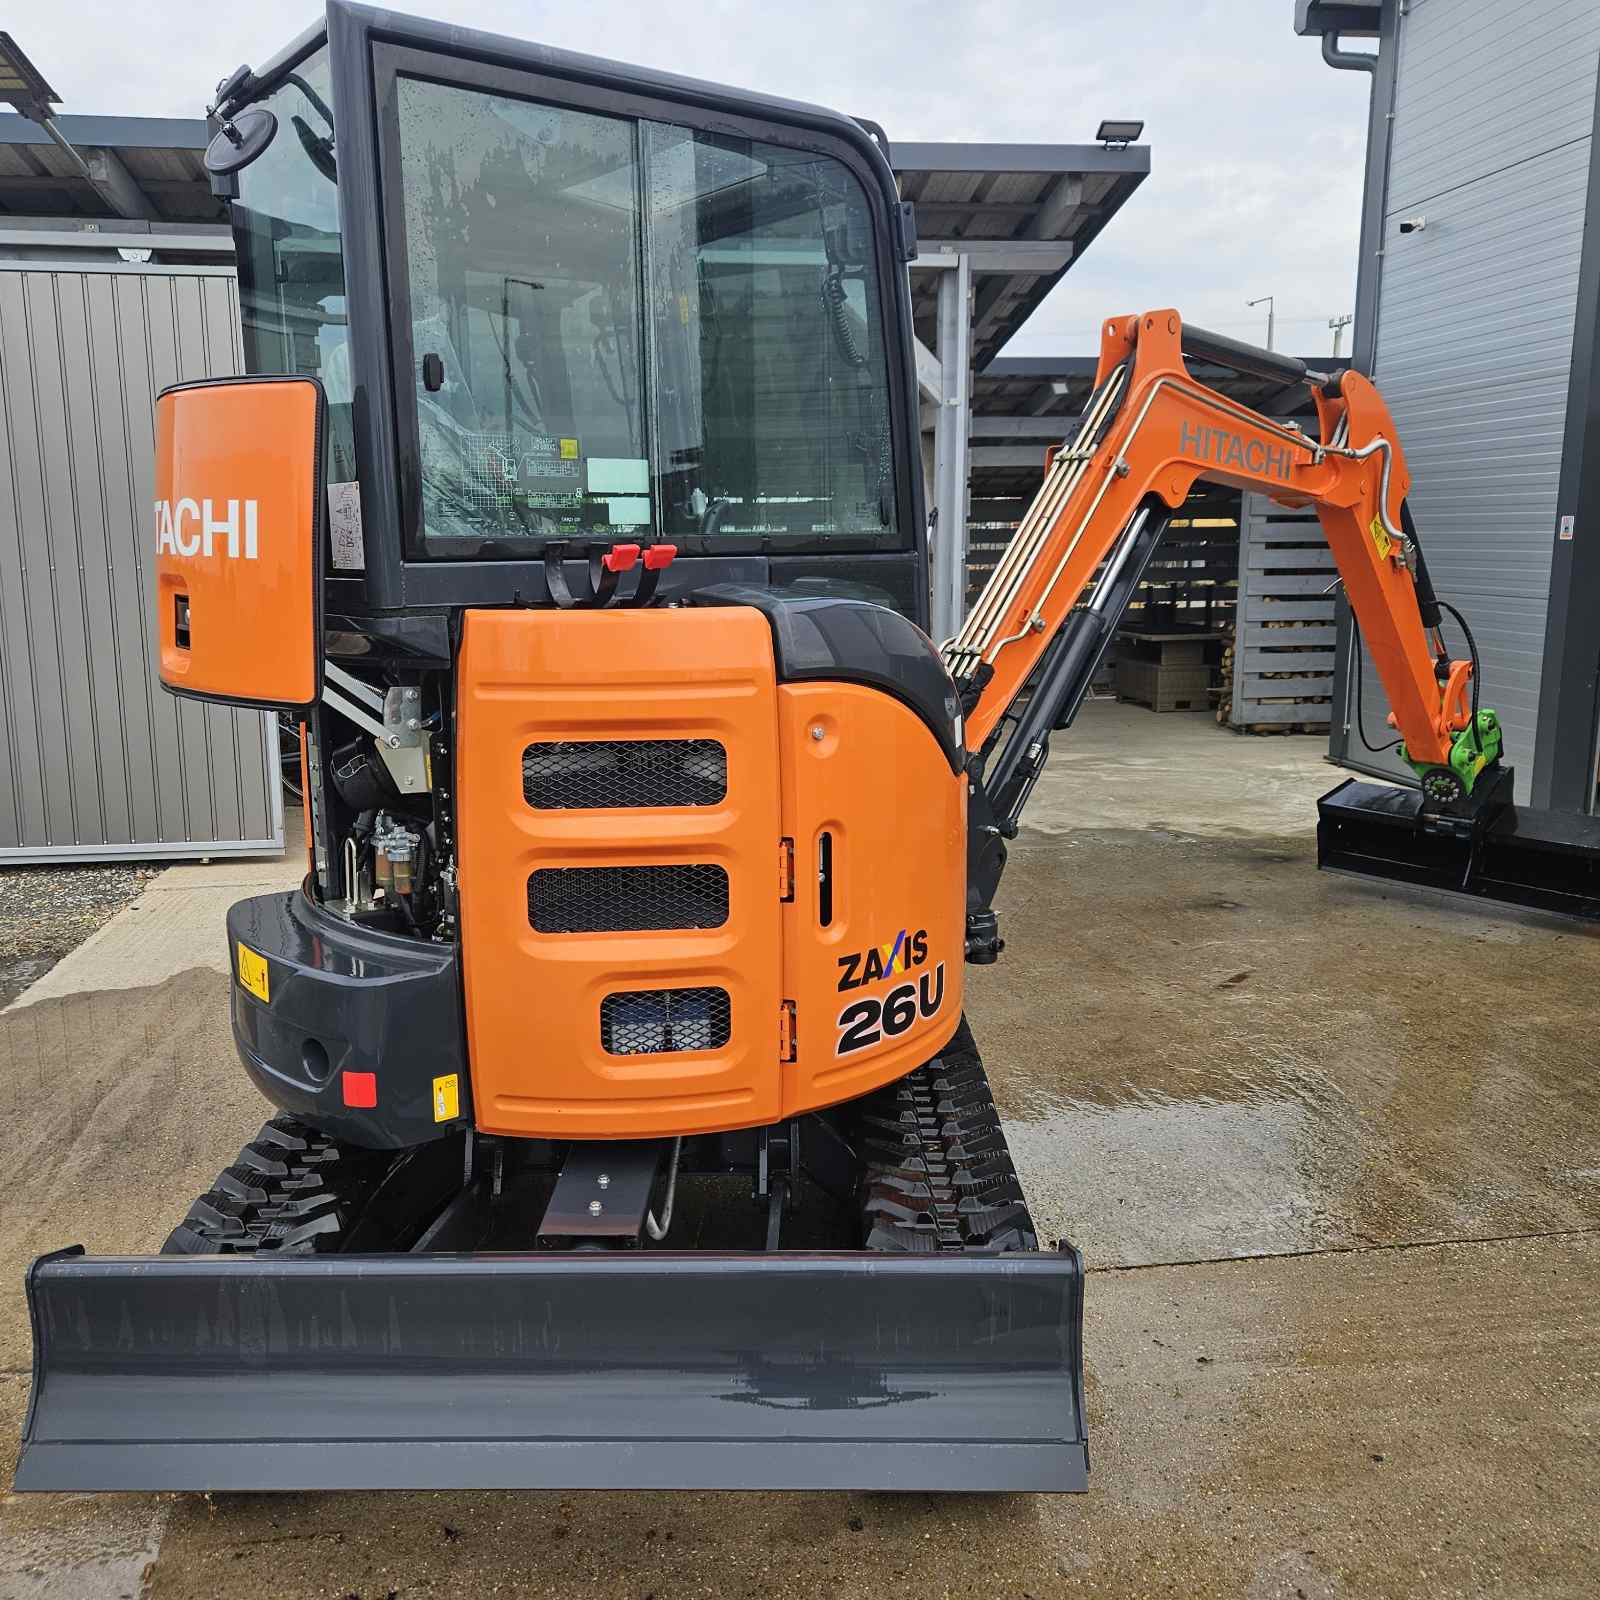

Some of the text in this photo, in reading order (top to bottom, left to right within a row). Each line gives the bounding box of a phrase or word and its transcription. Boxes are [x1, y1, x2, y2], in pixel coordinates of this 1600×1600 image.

[1180, 422, 1293, 480] HITACHI
[838, 929, 928, 992] ZAXIS
[837, 963, 945, 1054] 26U
